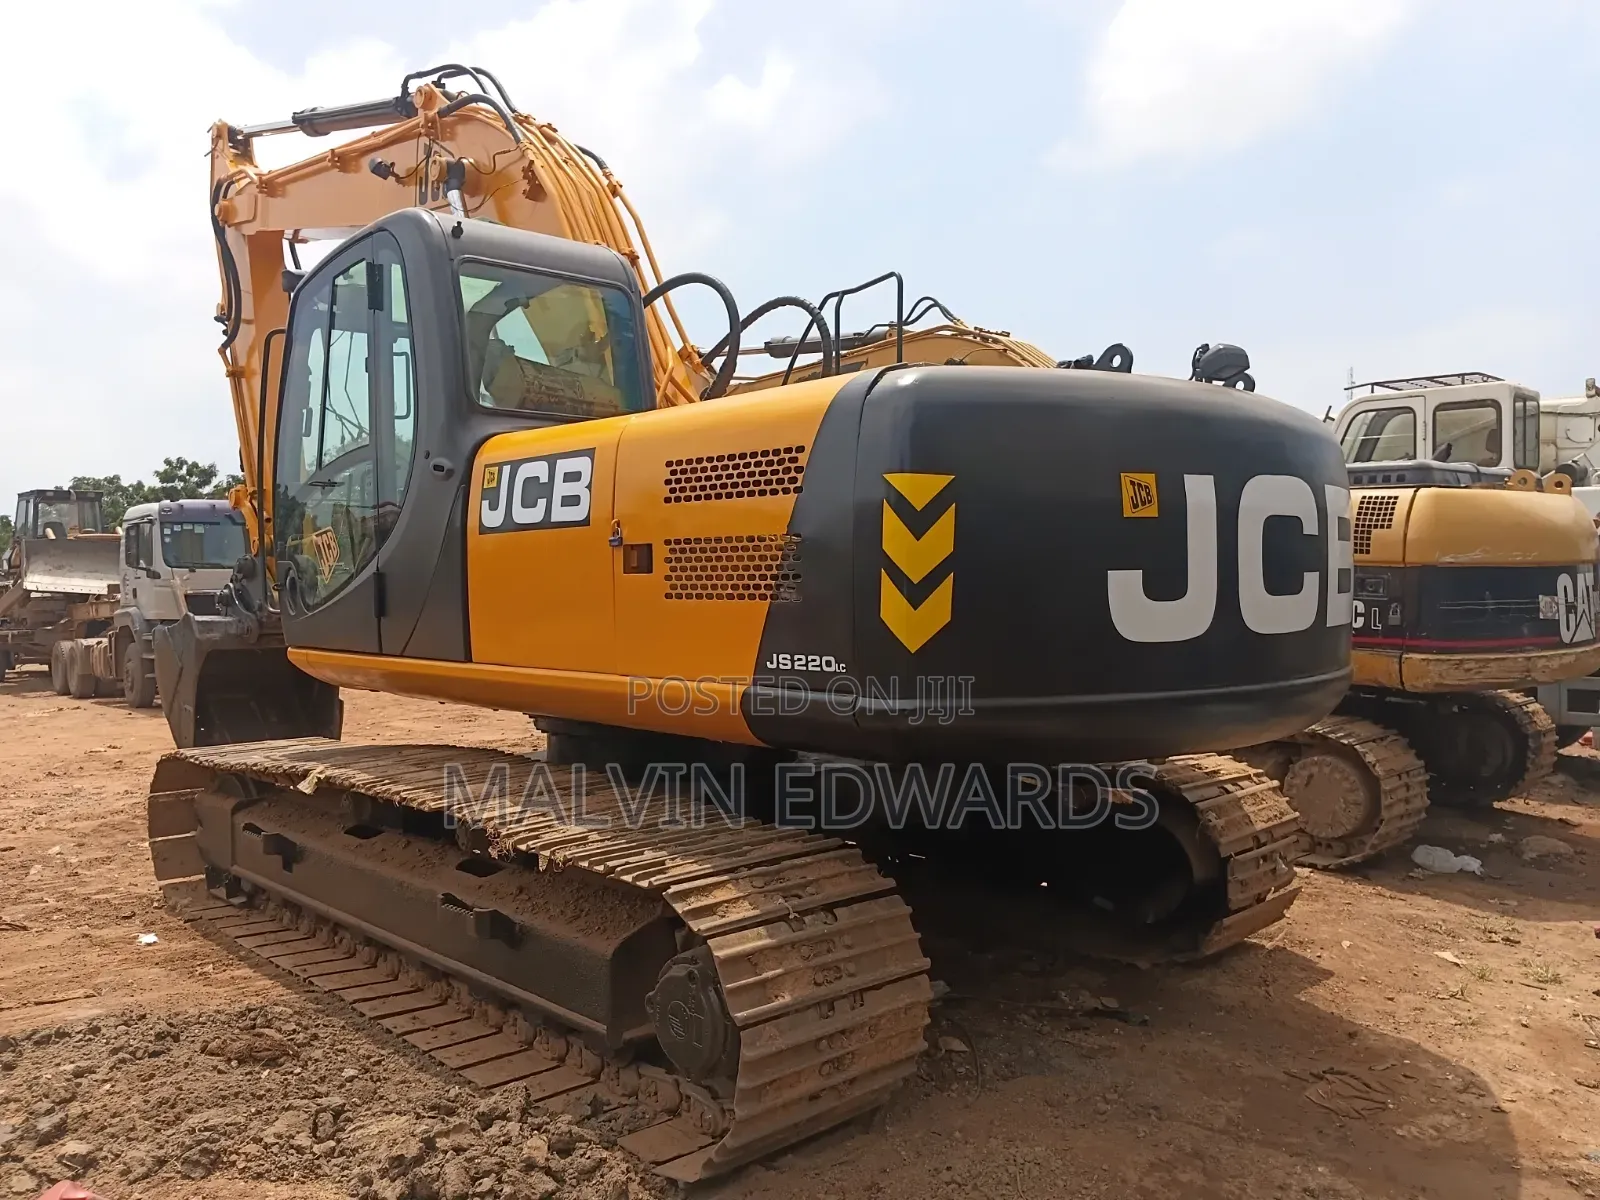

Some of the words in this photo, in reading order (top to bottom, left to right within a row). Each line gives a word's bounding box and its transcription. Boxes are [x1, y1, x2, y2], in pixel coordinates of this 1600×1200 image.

[481, 456, 592, 528] JCB
[1129, 479, 1153, 510] JCB
[315, 531, 338, 577] JCB
[1371, 607, 1382, 630] L
[1557, 573, 1596, 644] CAT
